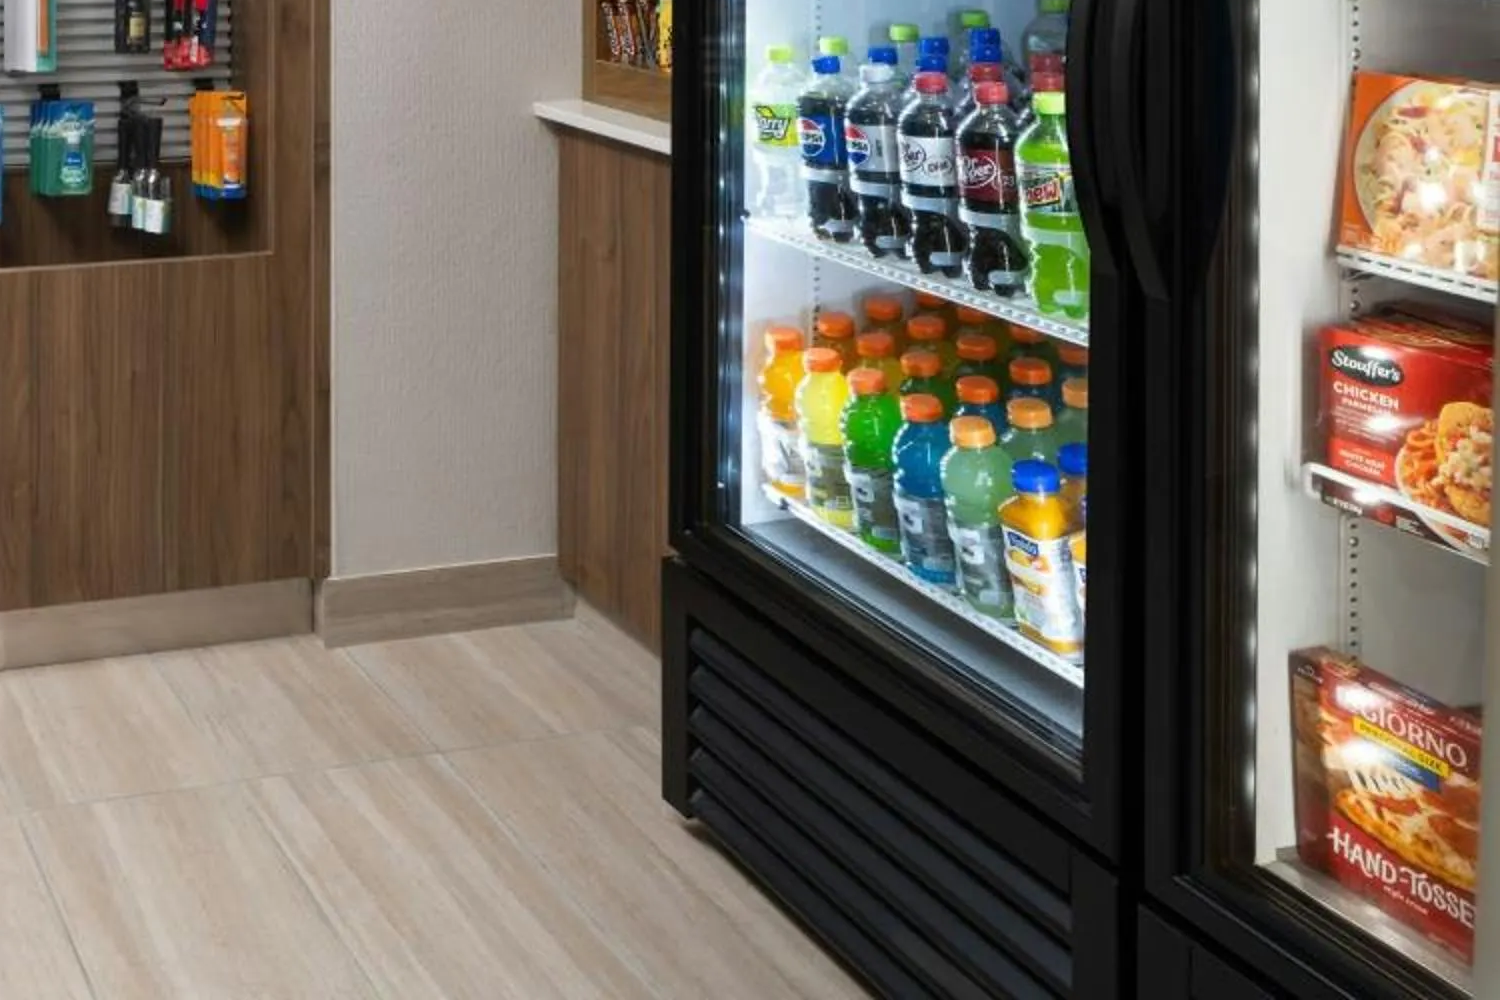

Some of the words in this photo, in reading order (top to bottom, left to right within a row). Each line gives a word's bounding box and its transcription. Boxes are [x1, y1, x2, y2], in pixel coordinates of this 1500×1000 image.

[1331, 349, 1400, 383] Stouffer's
[1333, 381, 1400, 410] CHICKEN
[1326, 826, 1476, 929] HAND-TOSSE
